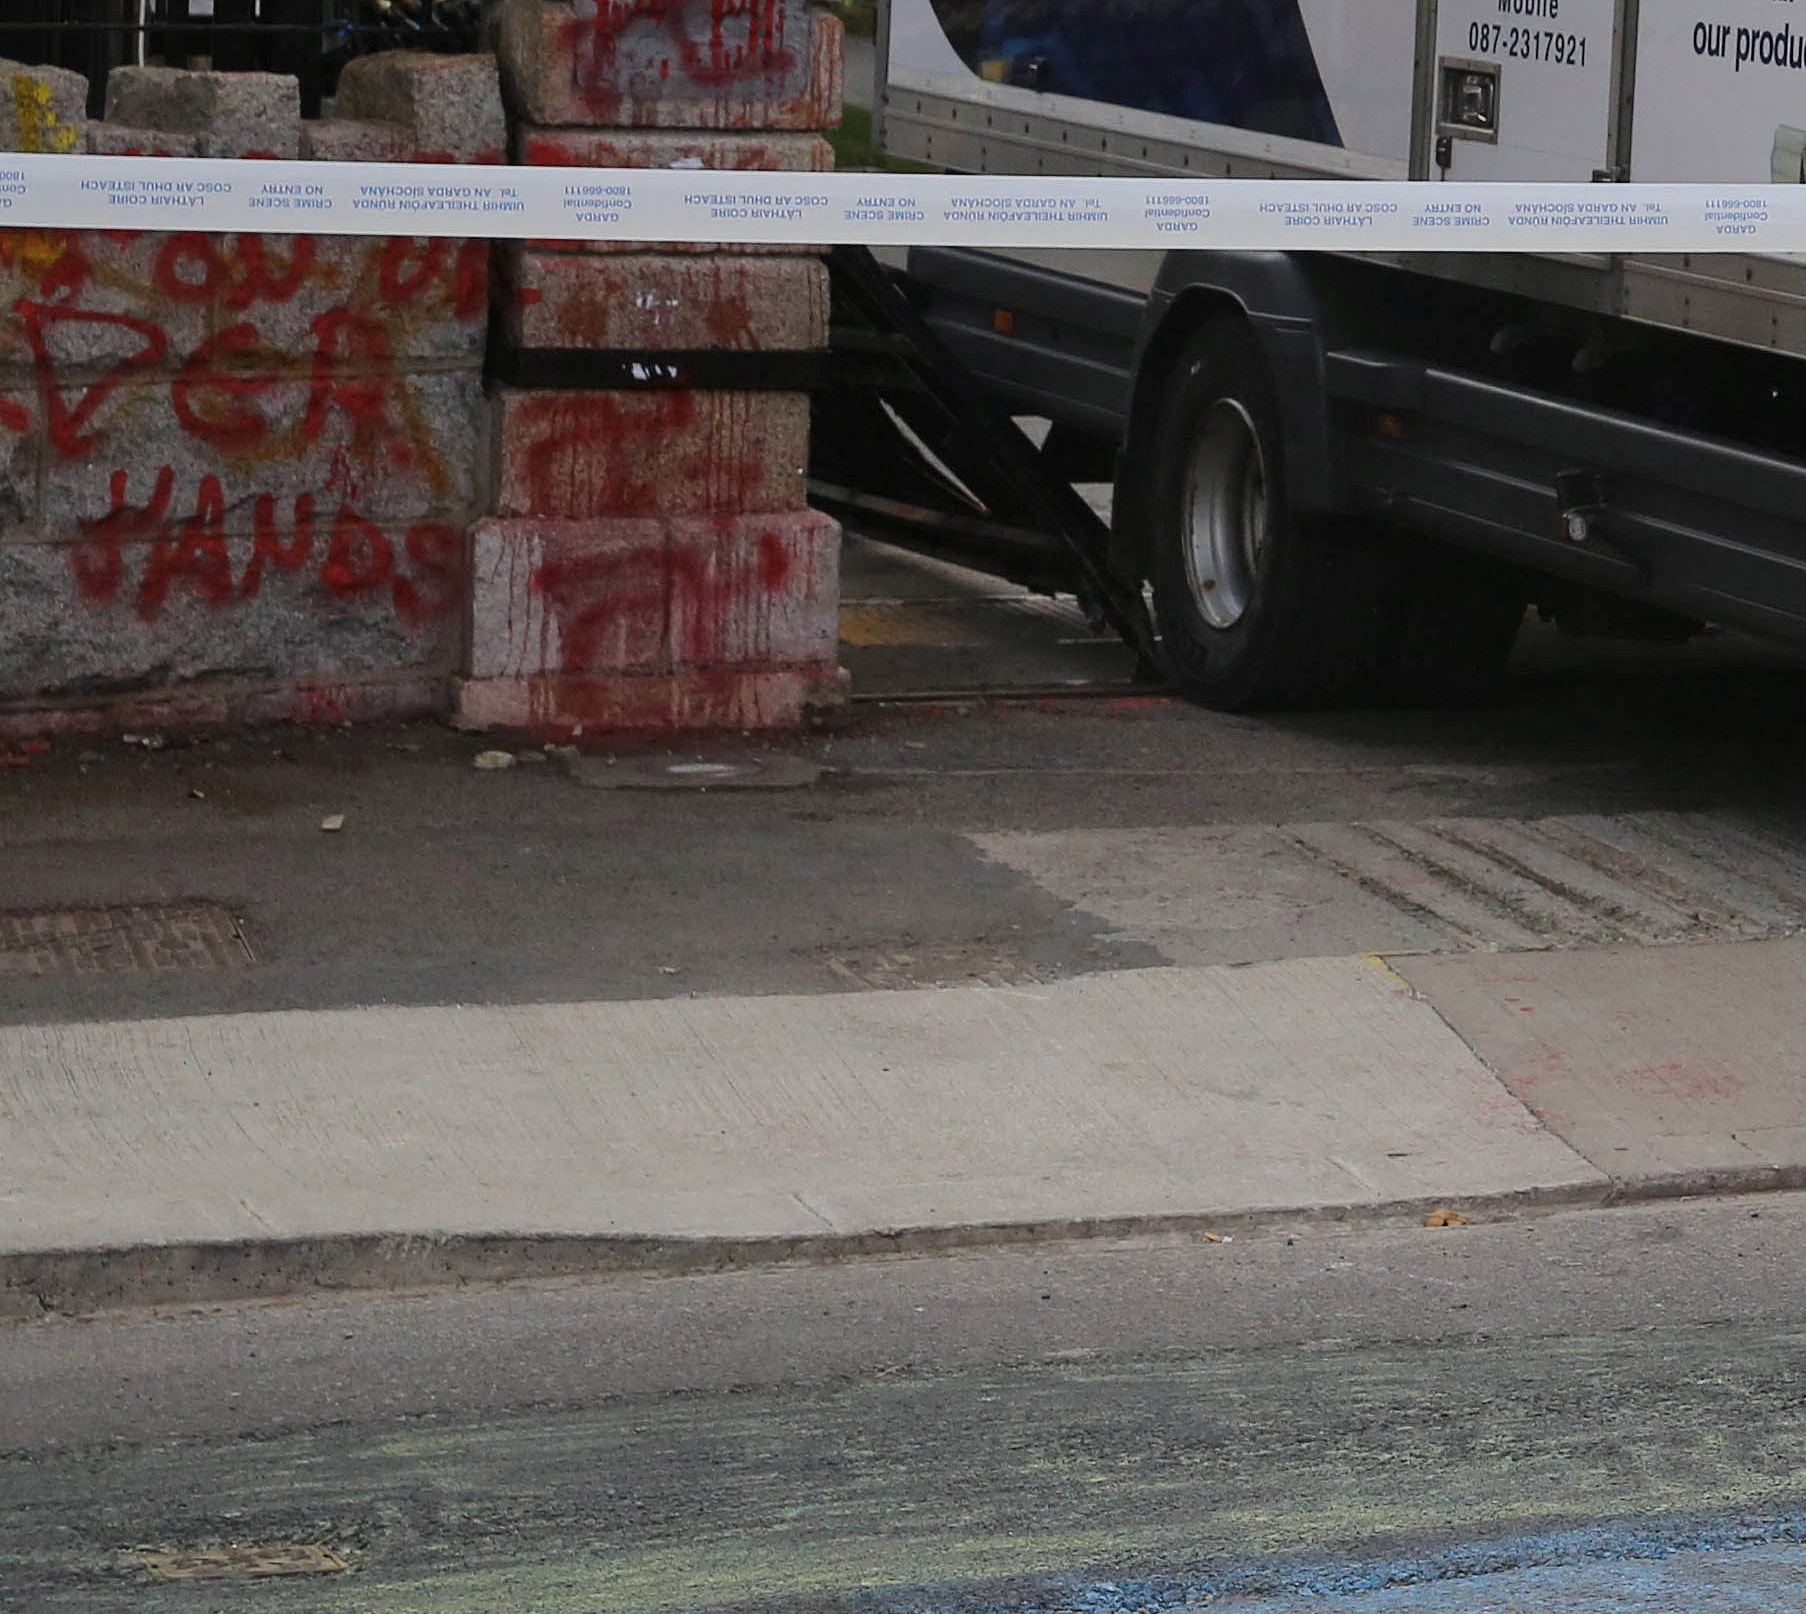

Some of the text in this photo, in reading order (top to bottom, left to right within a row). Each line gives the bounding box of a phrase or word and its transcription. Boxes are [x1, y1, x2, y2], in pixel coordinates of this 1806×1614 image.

[1469, 22, 1587, 68] 087-2317921
[1693, 21, 1731, 58] our
[81, 180, 232, 193] COSC AR DHUL ISTEACH
[261, 184, 323, 195] NO ENTRY
[427, 187, 471, 198] GARDA
[474, 187, 492, 198] AN
[109, 194, 147, 205] COIRE
[249, 197, 332, 209] CRIME SCENE
[563, 199, 632, 209] Confidential
[684, 194, 828, 208] COSC AR DHUL ISTEACH
[856, 197, 916, 208] NO ENTRY
[1015, 198, 1057, 209] GARDA
[1059, 199, 1076, 209] AN
[483, 201, 524, 211] UIMHIR
[1260, 203, 1398, 214] COSC AR DHUL ISTEACH
[1424, 204, 1481, 214] NO ENTRY
[1576, 203, 1618, 213] GARDA
[1621, 203, 1637, 213] AN
[576, 212, 619, 222] GARDA
[711, 208, 748, 218] COIRE
[844, 210, 924, 221] CRIME SCENE
[1067, 211, 1108, 222] UIMHIR
[1144, 208, 1210, 219] Confidential
[1705, 212, 1768, 222] Confidential
[1156, 222, 1198, 231] GARDA
[1285, 216, 1321, 227] COIRE
[1413, 216, 1490, 226] CRIME SCENE
[1628, 216, 1668, 226] UIMHIR
[1716, 225, 1756, 235] GARDA
